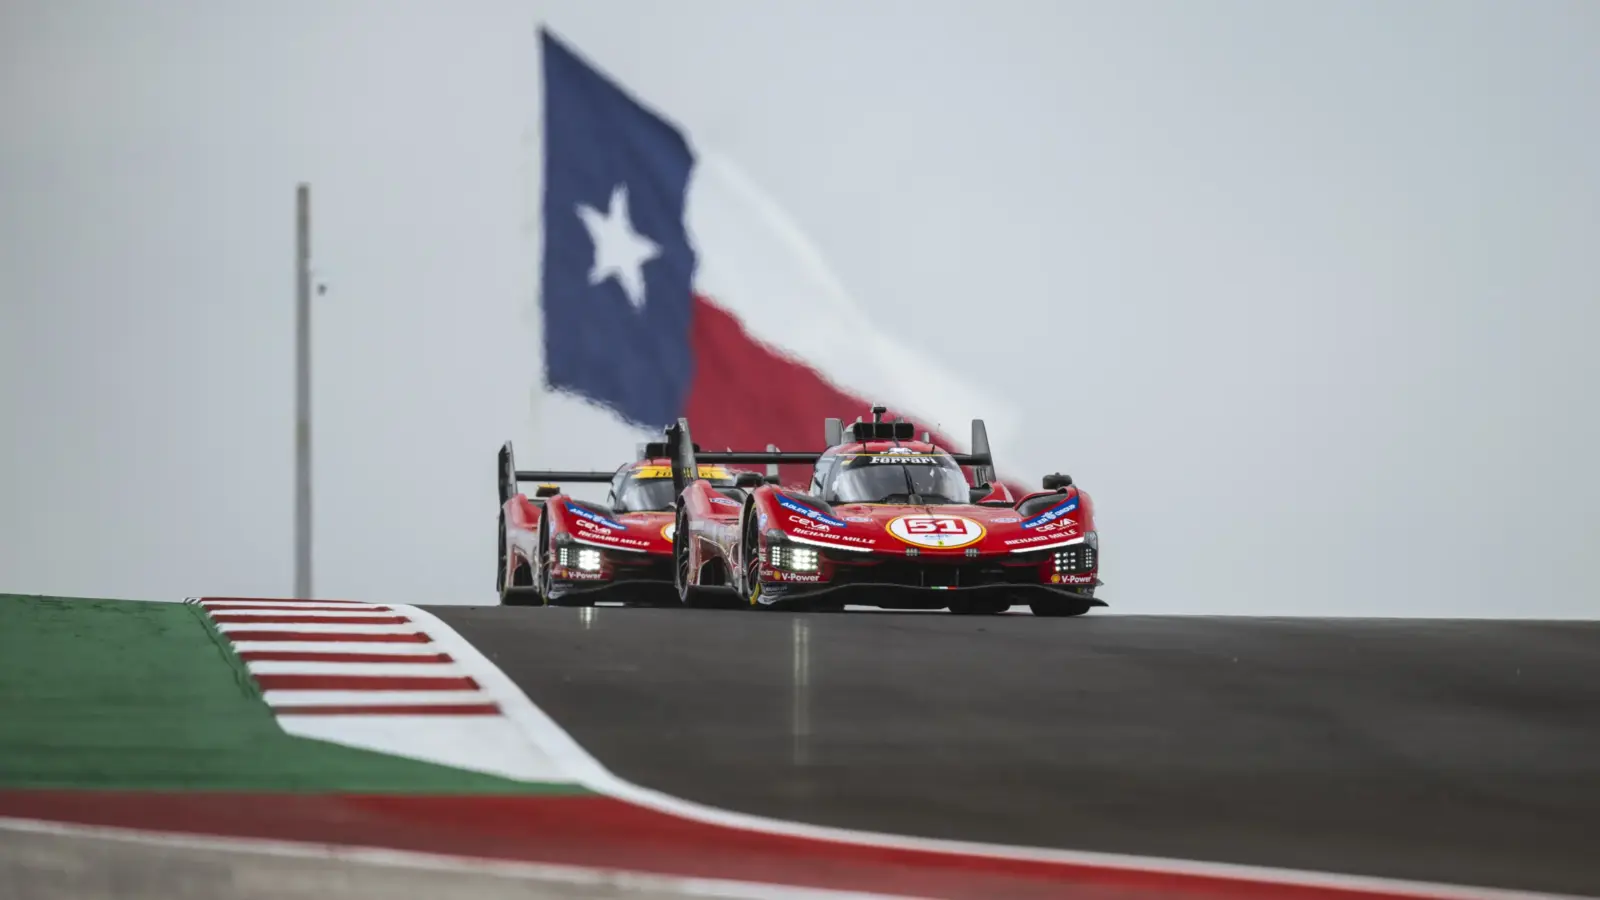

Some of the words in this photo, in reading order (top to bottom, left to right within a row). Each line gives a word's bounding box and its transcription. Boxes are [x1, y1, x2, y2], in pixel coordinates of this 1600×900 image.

[869, 456, 938, 464] Ferrari
[781, 502, 808, 514] ADLER
[817, 516, 844, 527] GROUP
[907, 519, 964, 532] 51
[1025, 517, 1049, 528] ADLER
[578, 530, 620, 542] RICHARD
[620, 538, 651, 546] MILLE
[793, 527, 841, 540] RICHARD
[842, 535, 876, 544] MILLE
[1004, 535, 1049, 545] RICHARD
[1048, 529, 1078, 539] MILLE
[568, 571, 602, 580] V-Power
[781, 572, 820, 581] V-Power
[1061, 575, 1092, 583] V-Power
